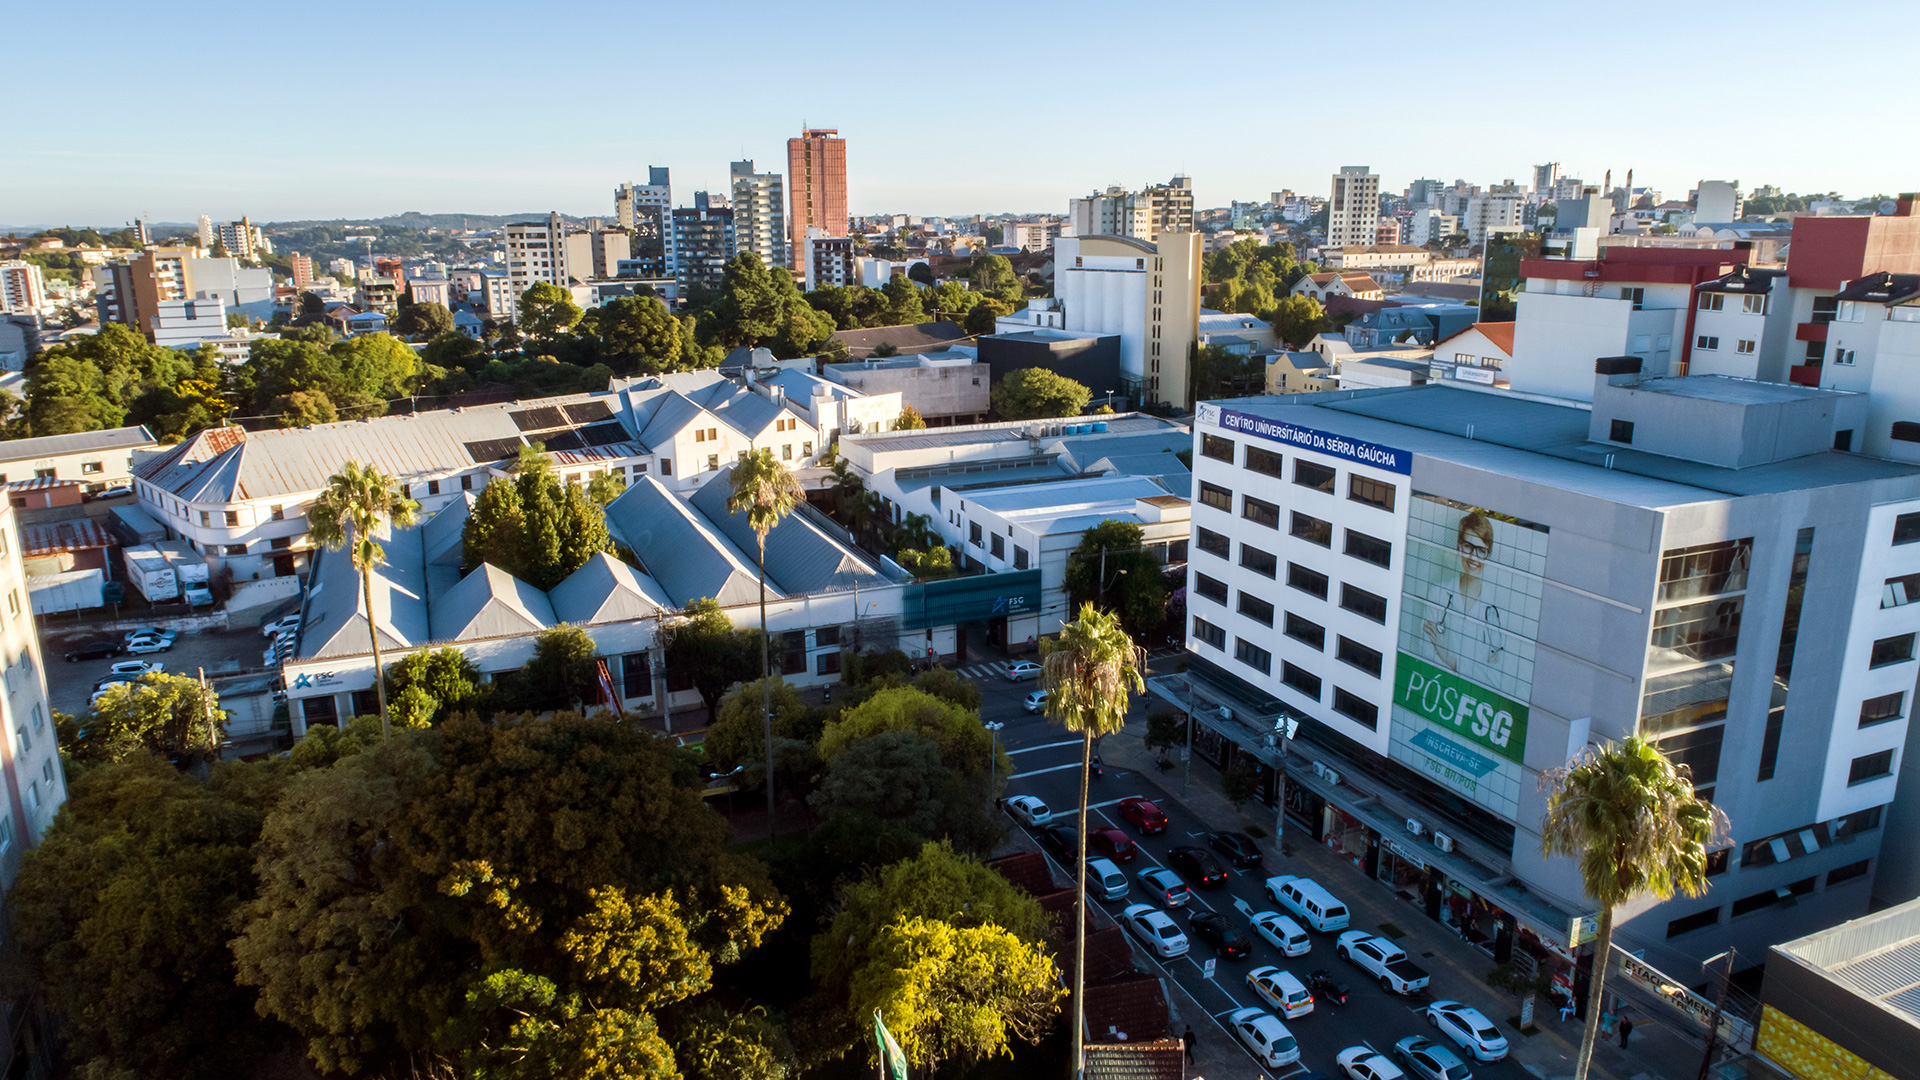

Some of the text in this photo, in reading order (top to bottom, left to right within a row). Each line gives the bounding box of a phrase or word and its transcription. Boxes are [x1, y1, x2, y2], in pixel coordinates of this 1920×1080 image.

[1225, 414, 1254, 431] CENTRO
[1255, 421, 1312, 446] UNIVERSITÁRIO
[1313, 435, 1325, 449] DA
[1326, 438, 1355, 456] SERRA
[1357, 446, 1396, 467] GAÚCHA
[1008, 596, 1024, 605] FSG
[316, 671, 335, 680] FSG
[1426, 735, 1481, 770] INSCREVA-SE
[1624, 959, 1725, 1026] ESTACIAMENTO
